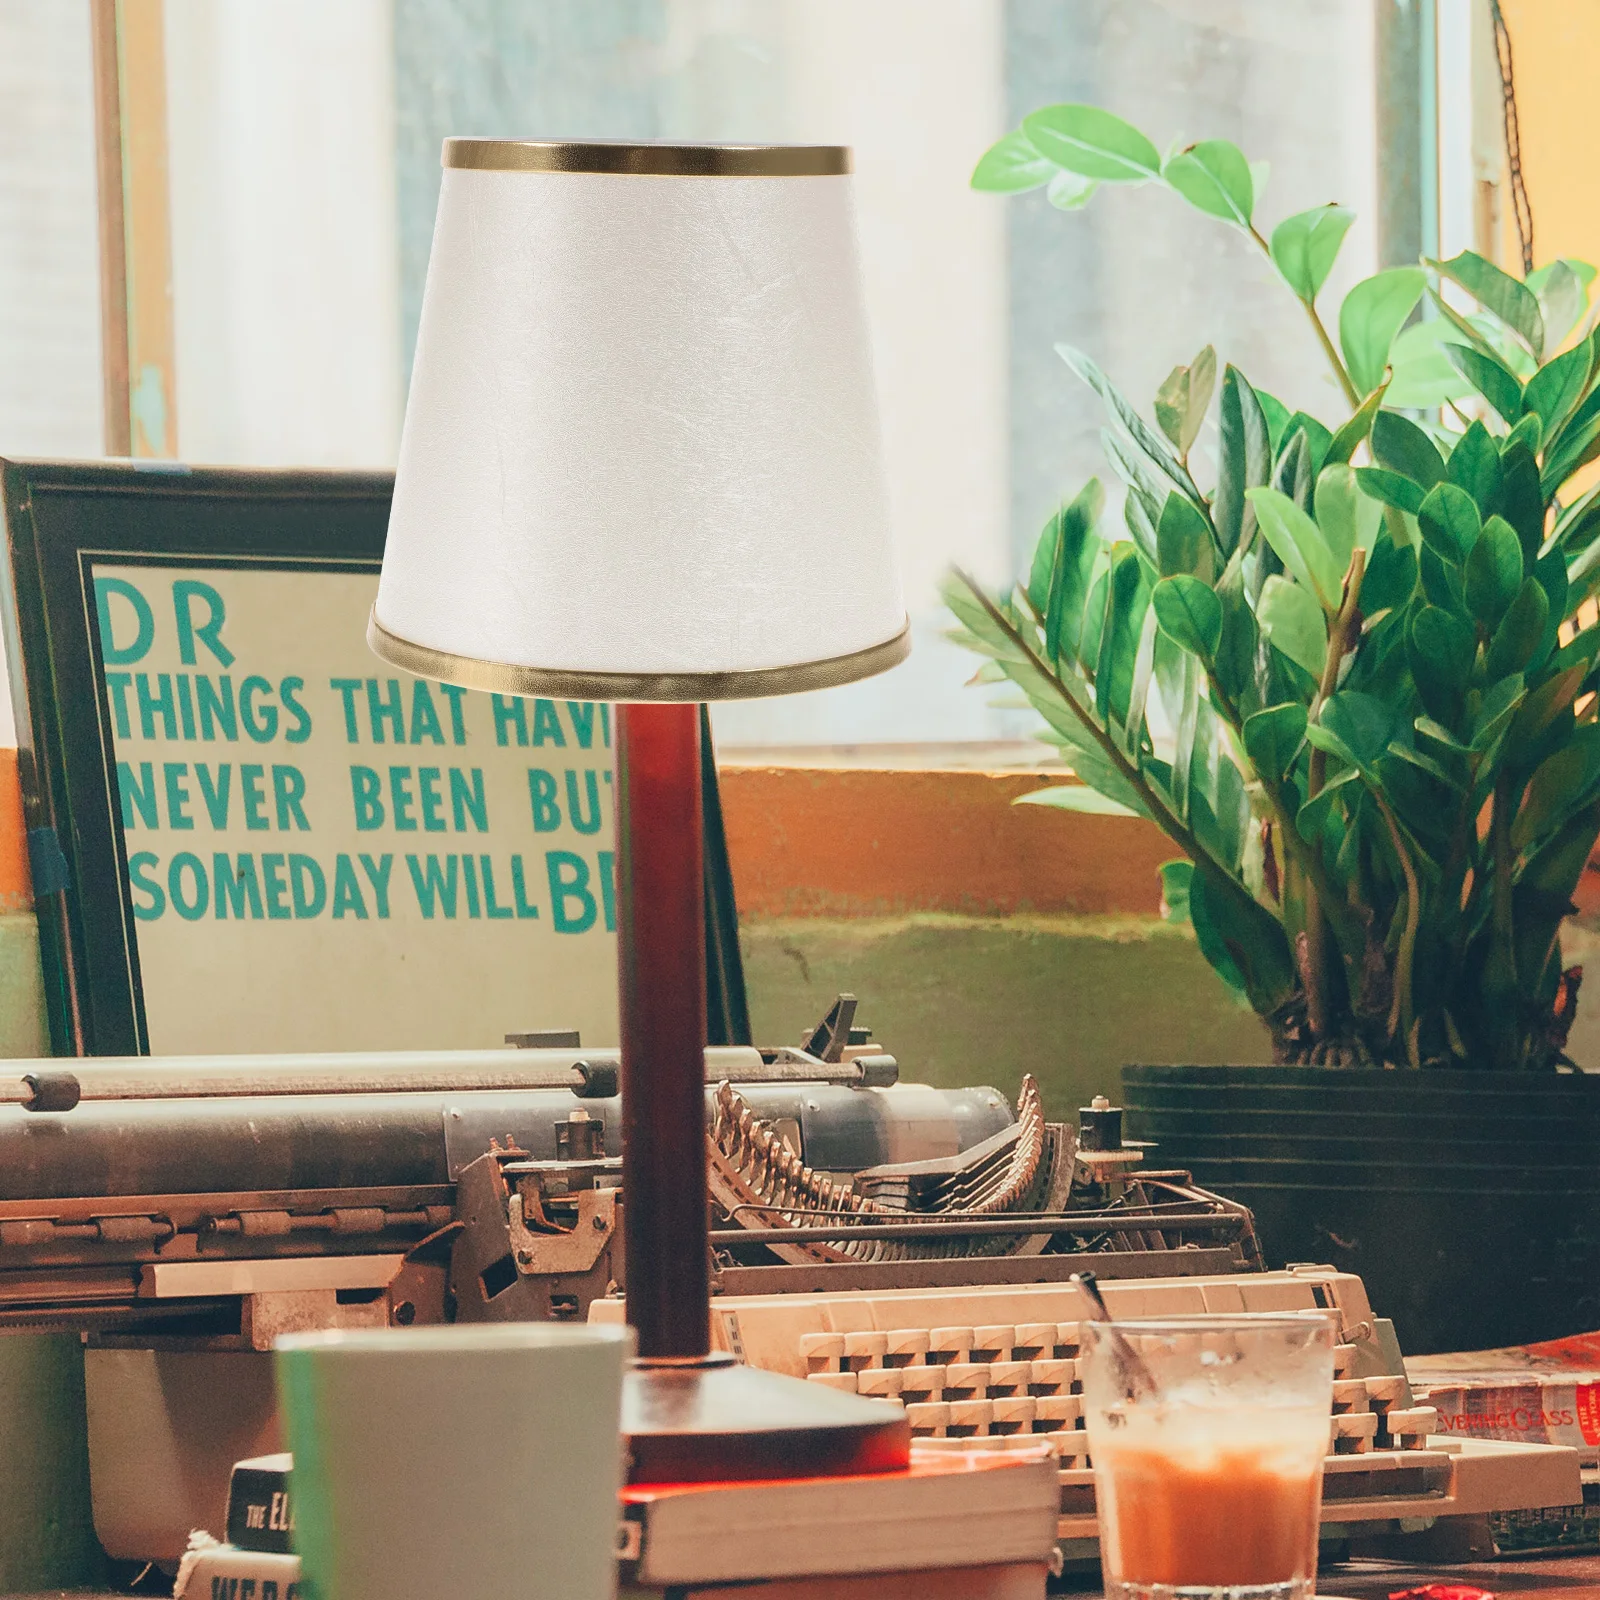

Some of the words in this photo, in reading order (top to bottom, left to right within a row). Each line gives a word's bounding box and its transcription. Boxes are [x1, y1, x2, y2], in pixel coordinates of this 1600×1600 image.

[104, 672, 312, 743] THINGS
[330, 678, 467, 745] THAT
[491, 691, 612, 749] HAV
[116, 762, 311, 831] NEVER
[350, 765, 489, 833] BEEN
[528, 768, 613, 834] BU
[127, 851, 393, 921] SOMEDAY
[405, 854, 539, 919] WILL
[1510, 1407, 1574, 1430] CLASS
[246, 1504, 267, 1529] THE
[269, 1491, 296, 1531] EL
